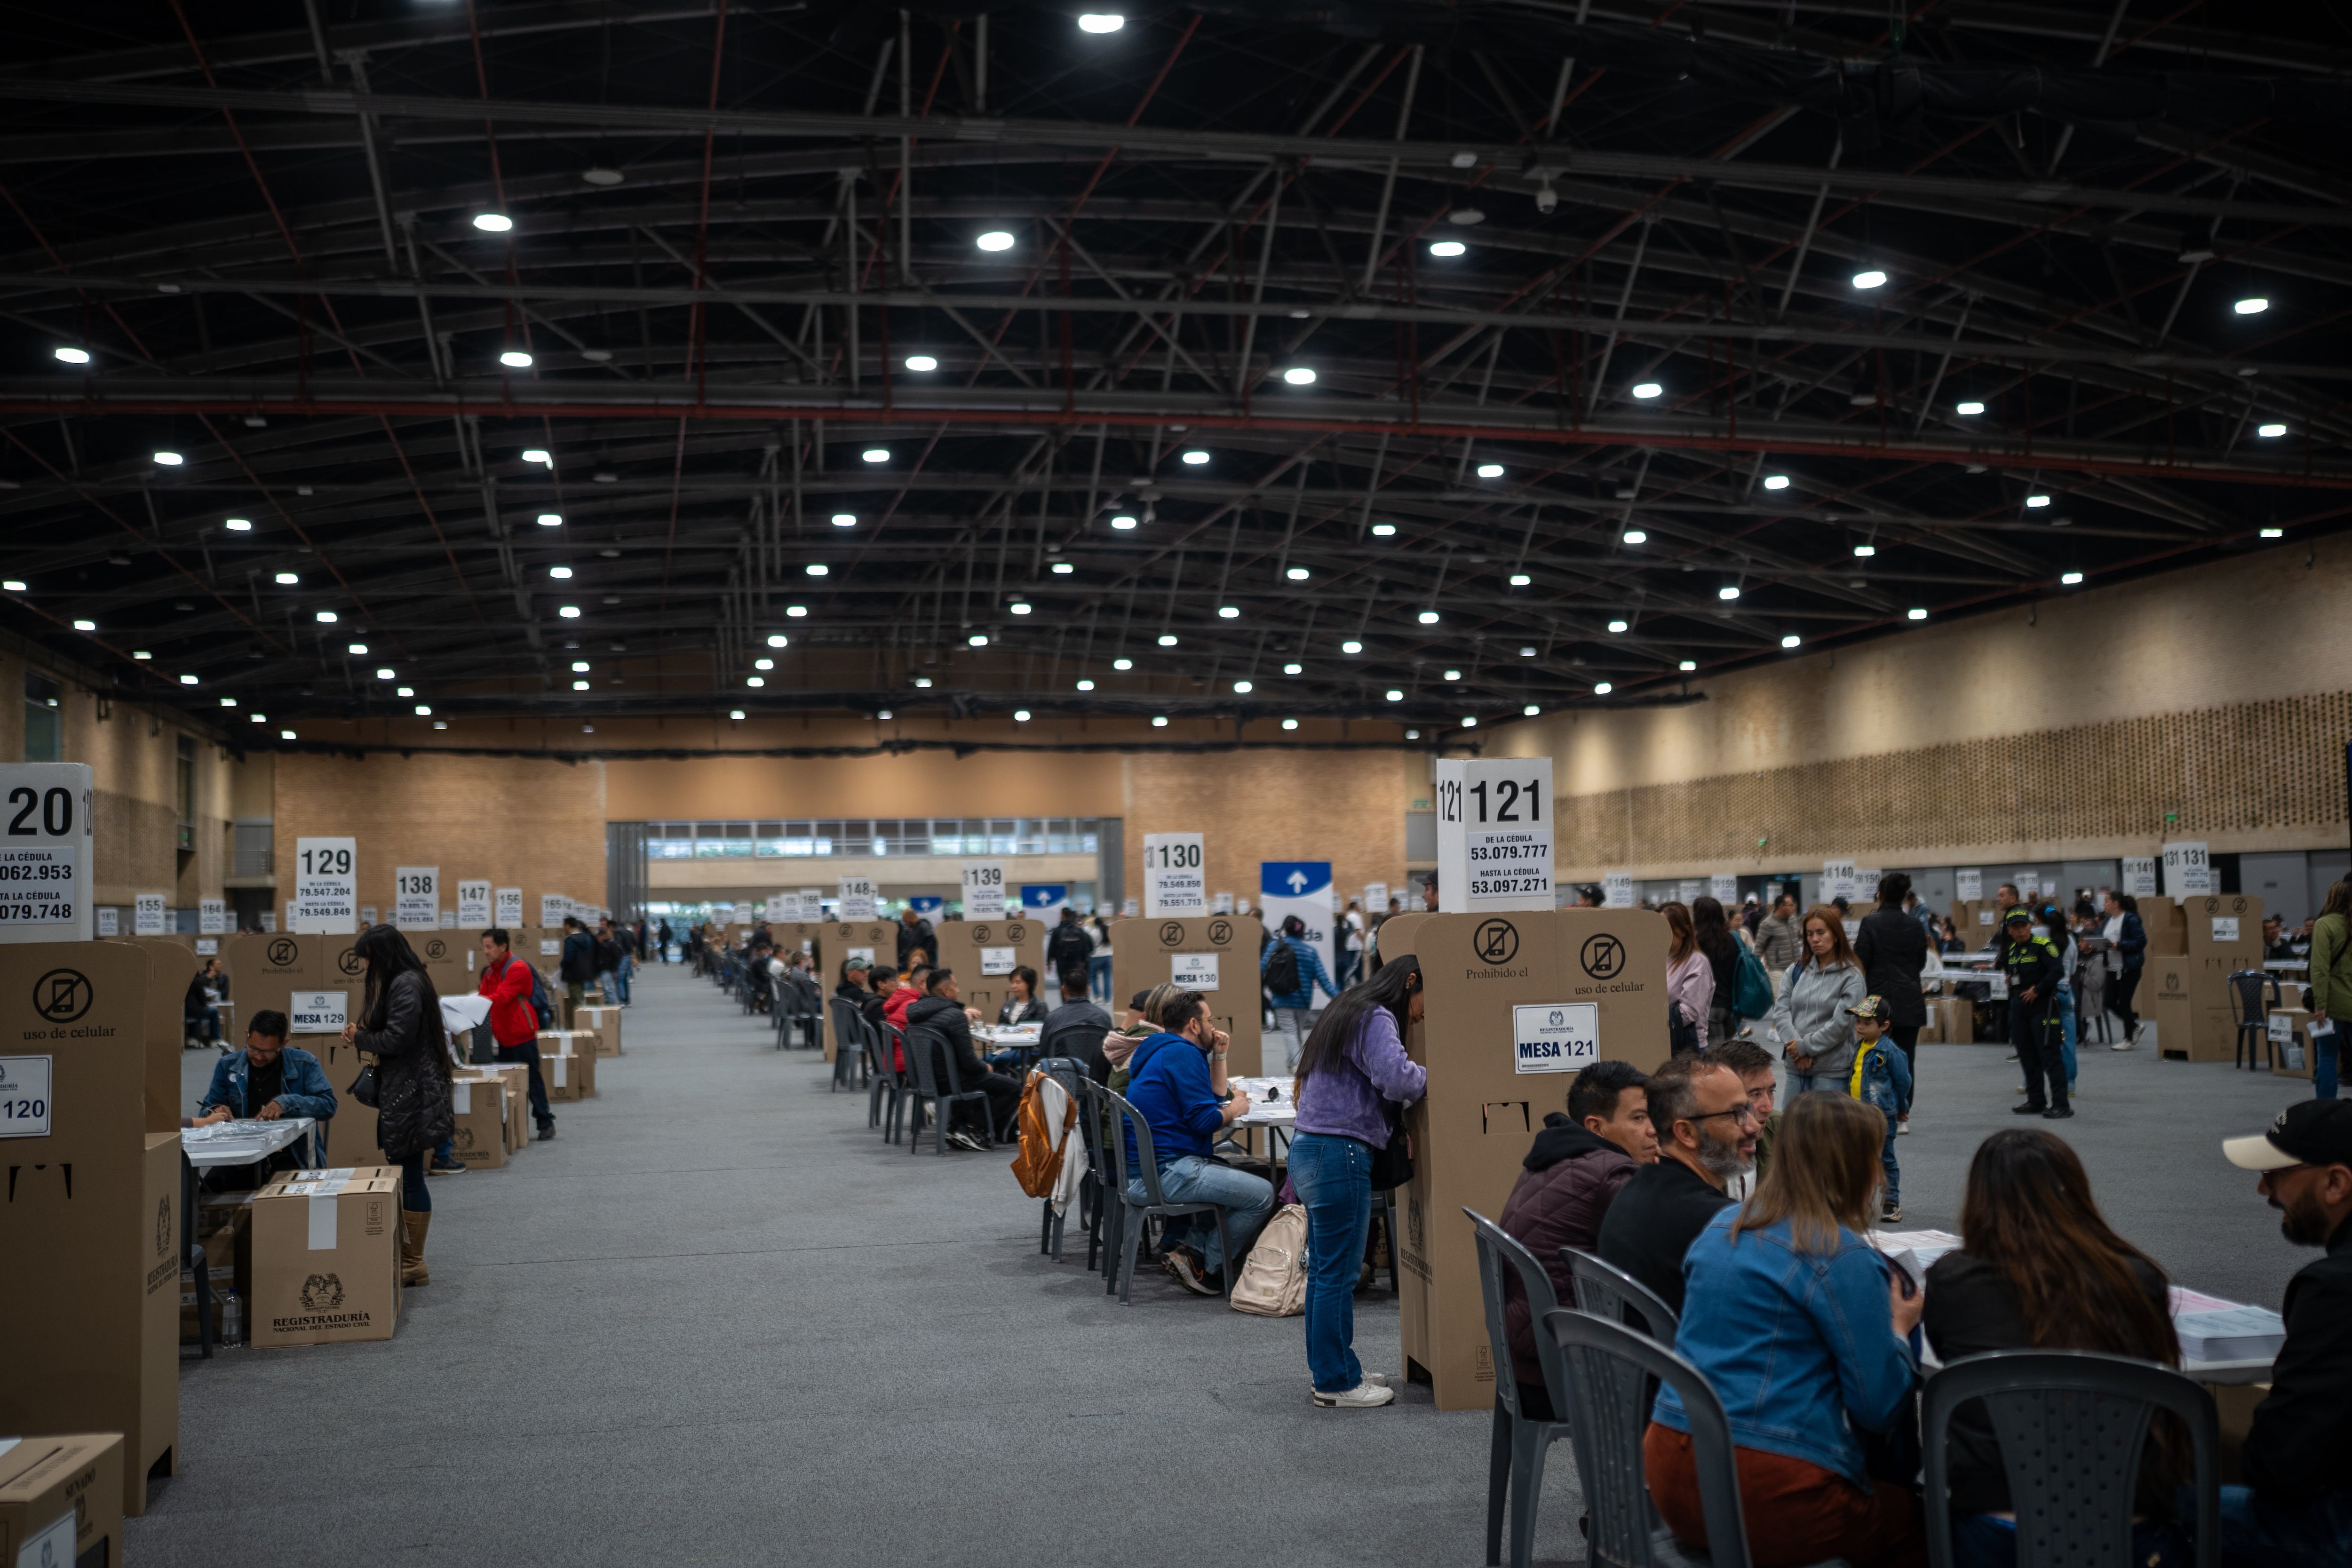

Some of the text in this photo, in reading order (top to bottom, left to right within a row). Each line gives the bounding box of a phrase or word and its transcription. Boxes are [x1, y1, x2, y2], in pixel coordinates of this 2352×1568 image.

[1440, 780, 1462, 822] 121
[1470, 780, 1539, 822] 121
[83, 788, 93, 836] 120
[18, 852, 52, 861] CÉDULA
[1159, 844, 1200, 868] 130
[1471, 845, 1547, 860] 53.079.777
[2164, 850, 2178, 867] 131
[2183, 850, 2206, 865] 131
[302, 850, 351, 875] 129
[2137, 862, 2153, 873] 141
[0, 865, 72, 881] 062.953
[971, 869, 1001, 885] 139
[1835, 866, 1853, 878] 140
[1865, 874, 1880, 884] 150
[399, 876, 432, 894] 138
[846, 883, 869, 896] 148
[1472, 878, 1547, 894] 53.097.271
[1614, 878, 1630, 888] 149
[1721, 880, 1735, 888] 159
[26, 891, 60, 900] CÉDULA
[461, 888, 485, 901] 147
[500, 894, 520, 905] 156
[803, 896, 819, 905] 166
[138, 900, 160, 911] 155
[203, 905, 221, 915] 164
[544, 900, 561, 909] 165
[0, 904, 72, 920] 079.748
[1175, 974, 1216, 983] MESA 130
[1466, 967, 1528, 979] Prohibido el
[1575, 982, 1645, 995] uso de celular
[294, 1014, 344, 1024] MESA 129
[24, 1026, 116, 1040] uso de celular
[1519, 1040, 1593, 1059] MESA 121
[4, 1099, 45, 1119] 120
[147, 1250, 178, 1287] REGISTRADURÍA
[1401, 1248, 1432, 1277] REGISTRADURÍA
[273, 1310, 371, 1327] REGISTRADURÍA
